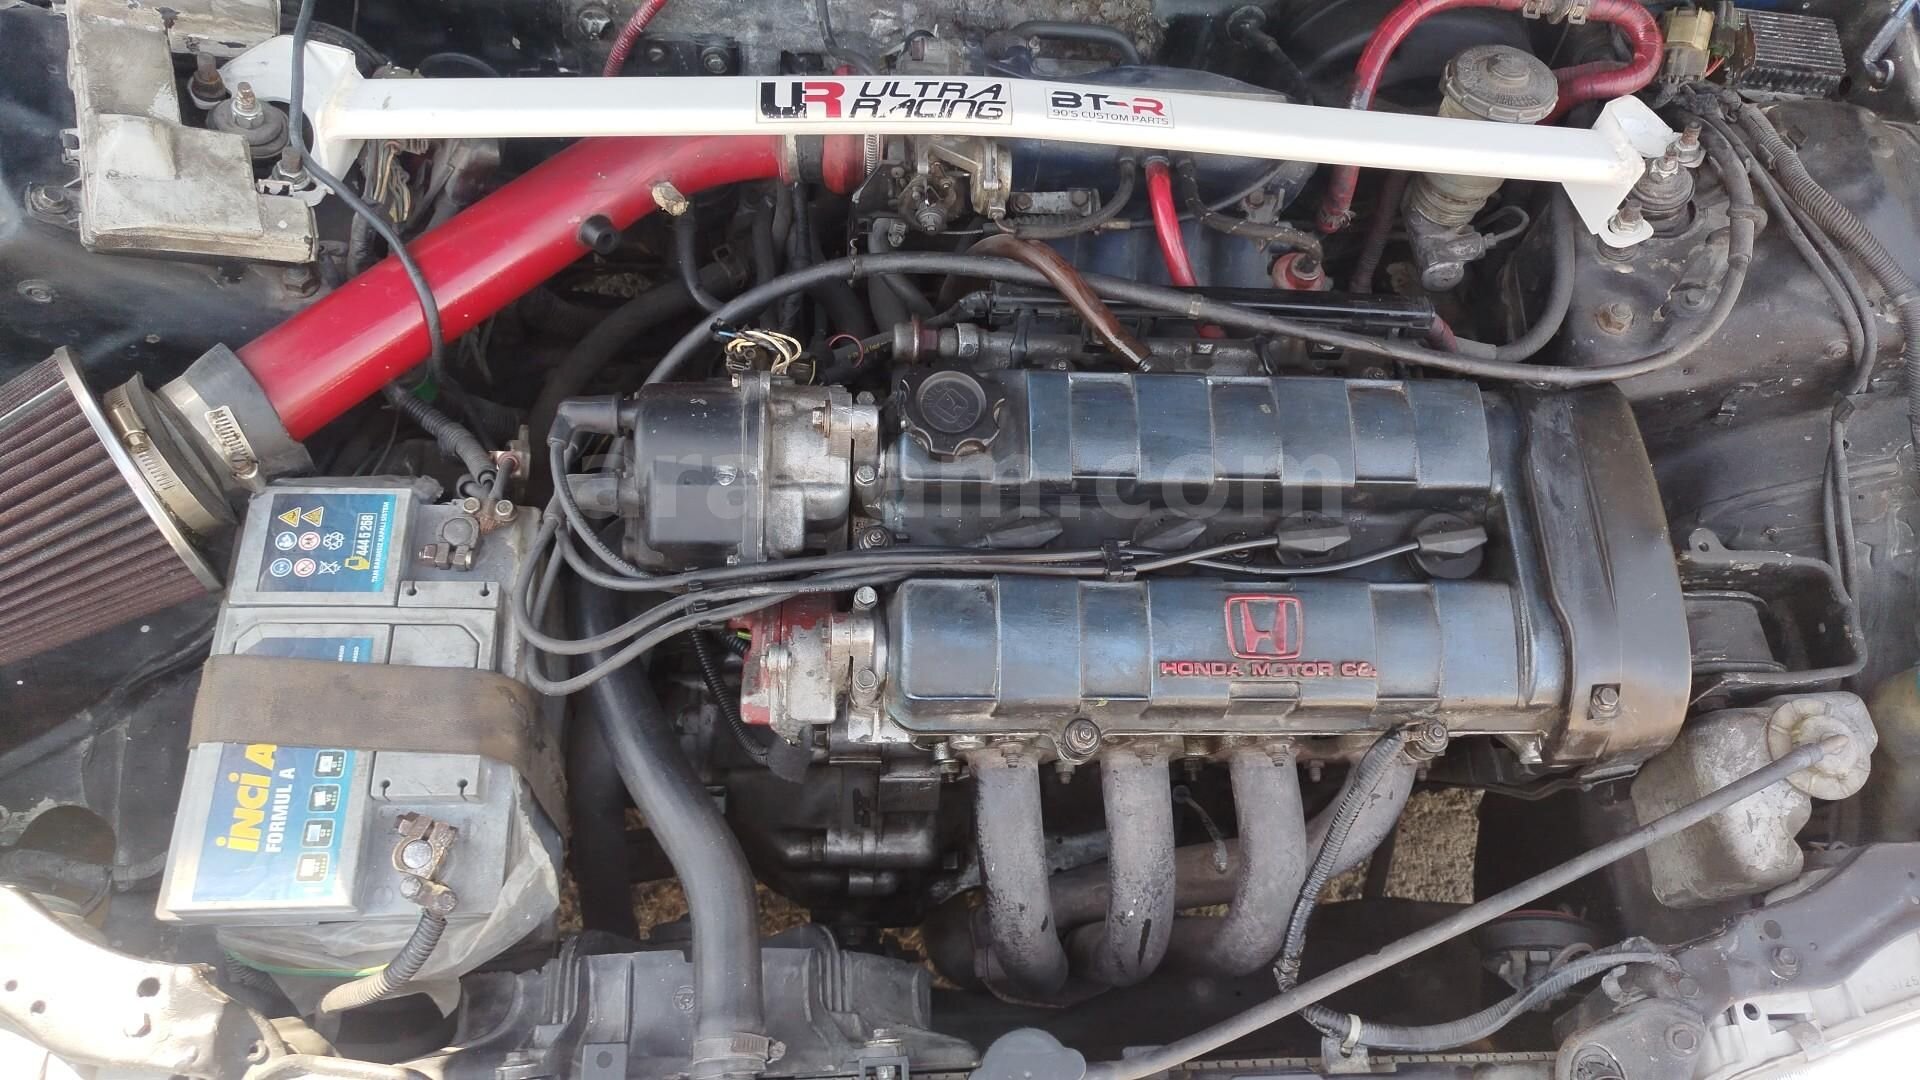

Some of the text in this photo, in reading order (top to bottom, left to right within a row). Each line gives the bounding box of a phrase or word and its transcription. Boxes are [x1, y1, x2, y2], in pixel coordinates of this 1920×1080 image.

[859, 81, 1002, 100] ULTRA
[848, 99, 1006, 120] RACING
[1051, 90, 1167, 117] BT-R
[1052, 108, 1170, 126] 90'S CUSTOM PARTS
[1160, 660, 1243, 678] HONDA
[1251, 661, 1334, 677] MOTOR
